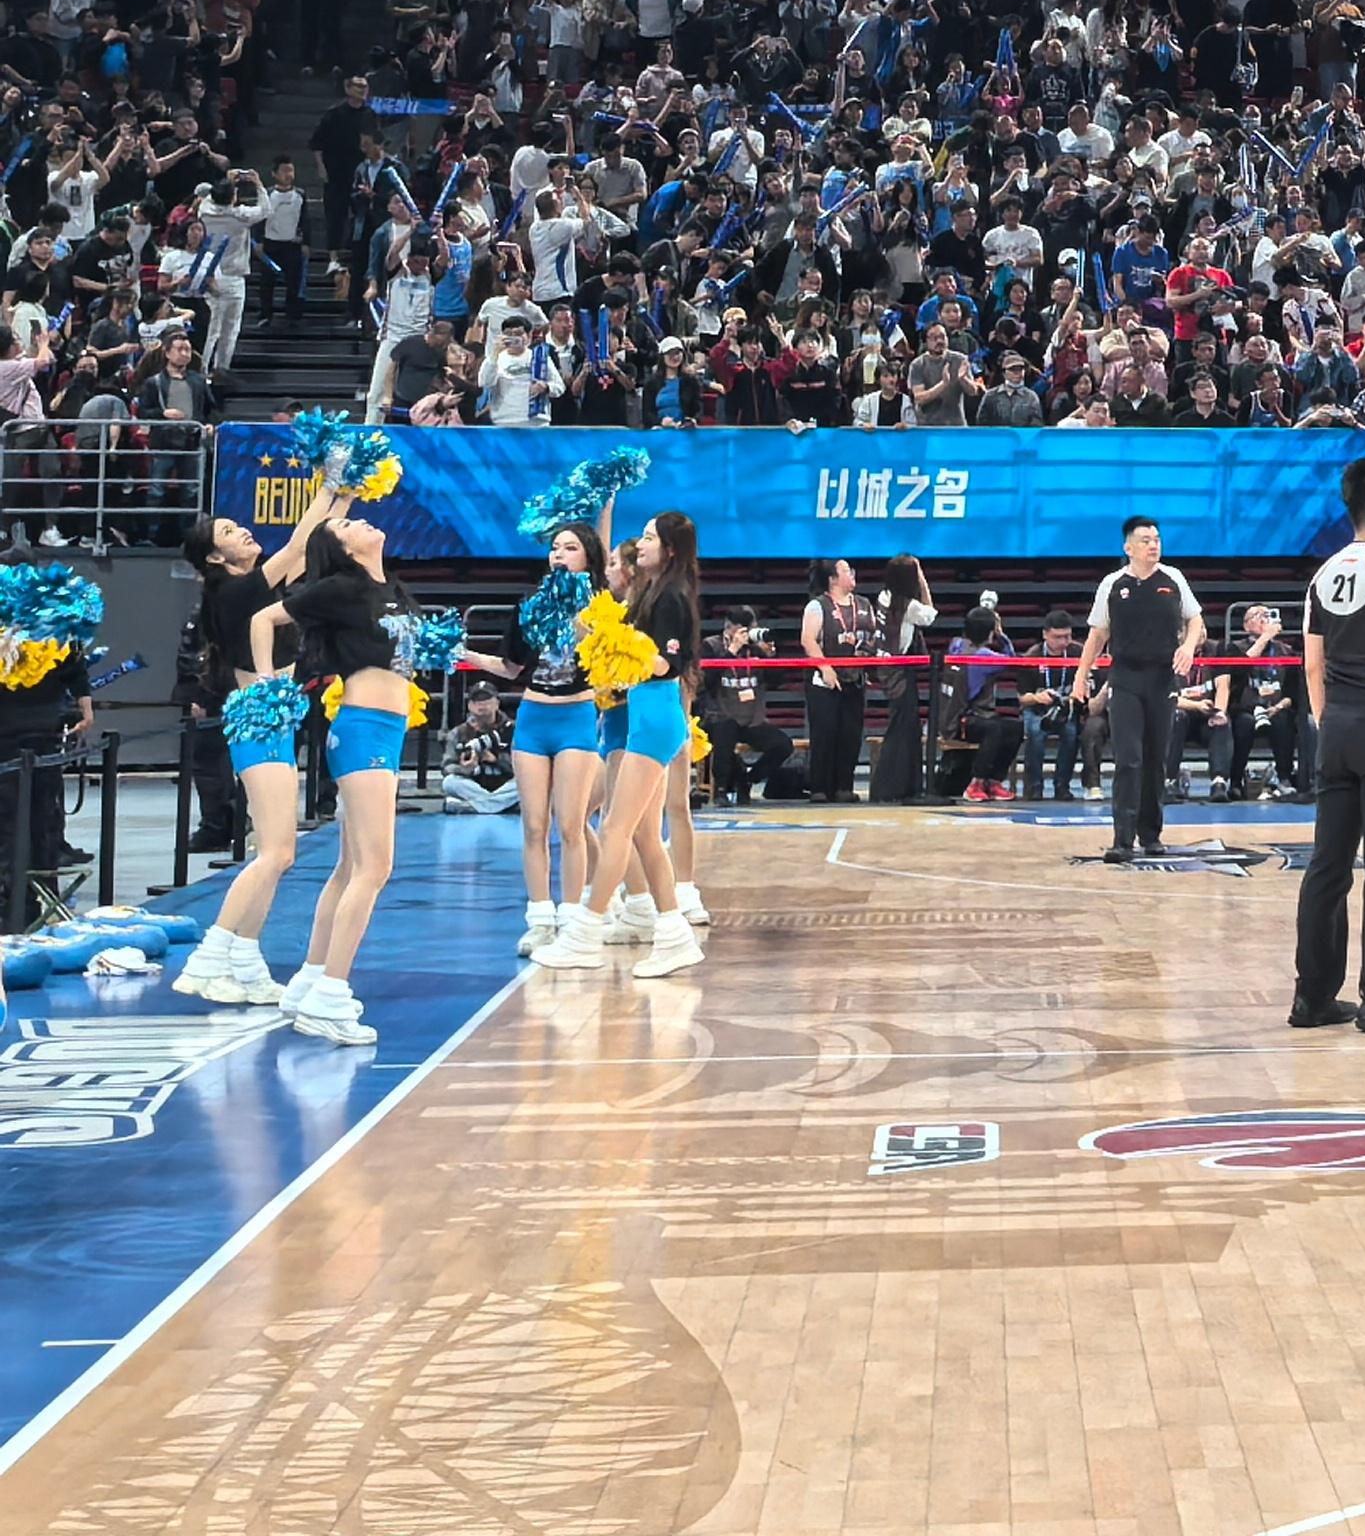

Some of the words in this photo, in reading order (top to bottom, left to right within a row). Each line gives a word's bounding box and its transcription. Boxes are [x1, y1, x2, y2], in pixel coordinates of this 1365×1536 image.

[253, 476, 318, 525] BEIJIN
[814, 466, 970, 521] 以城之名
[1331, 573, 1357, 603] 21
